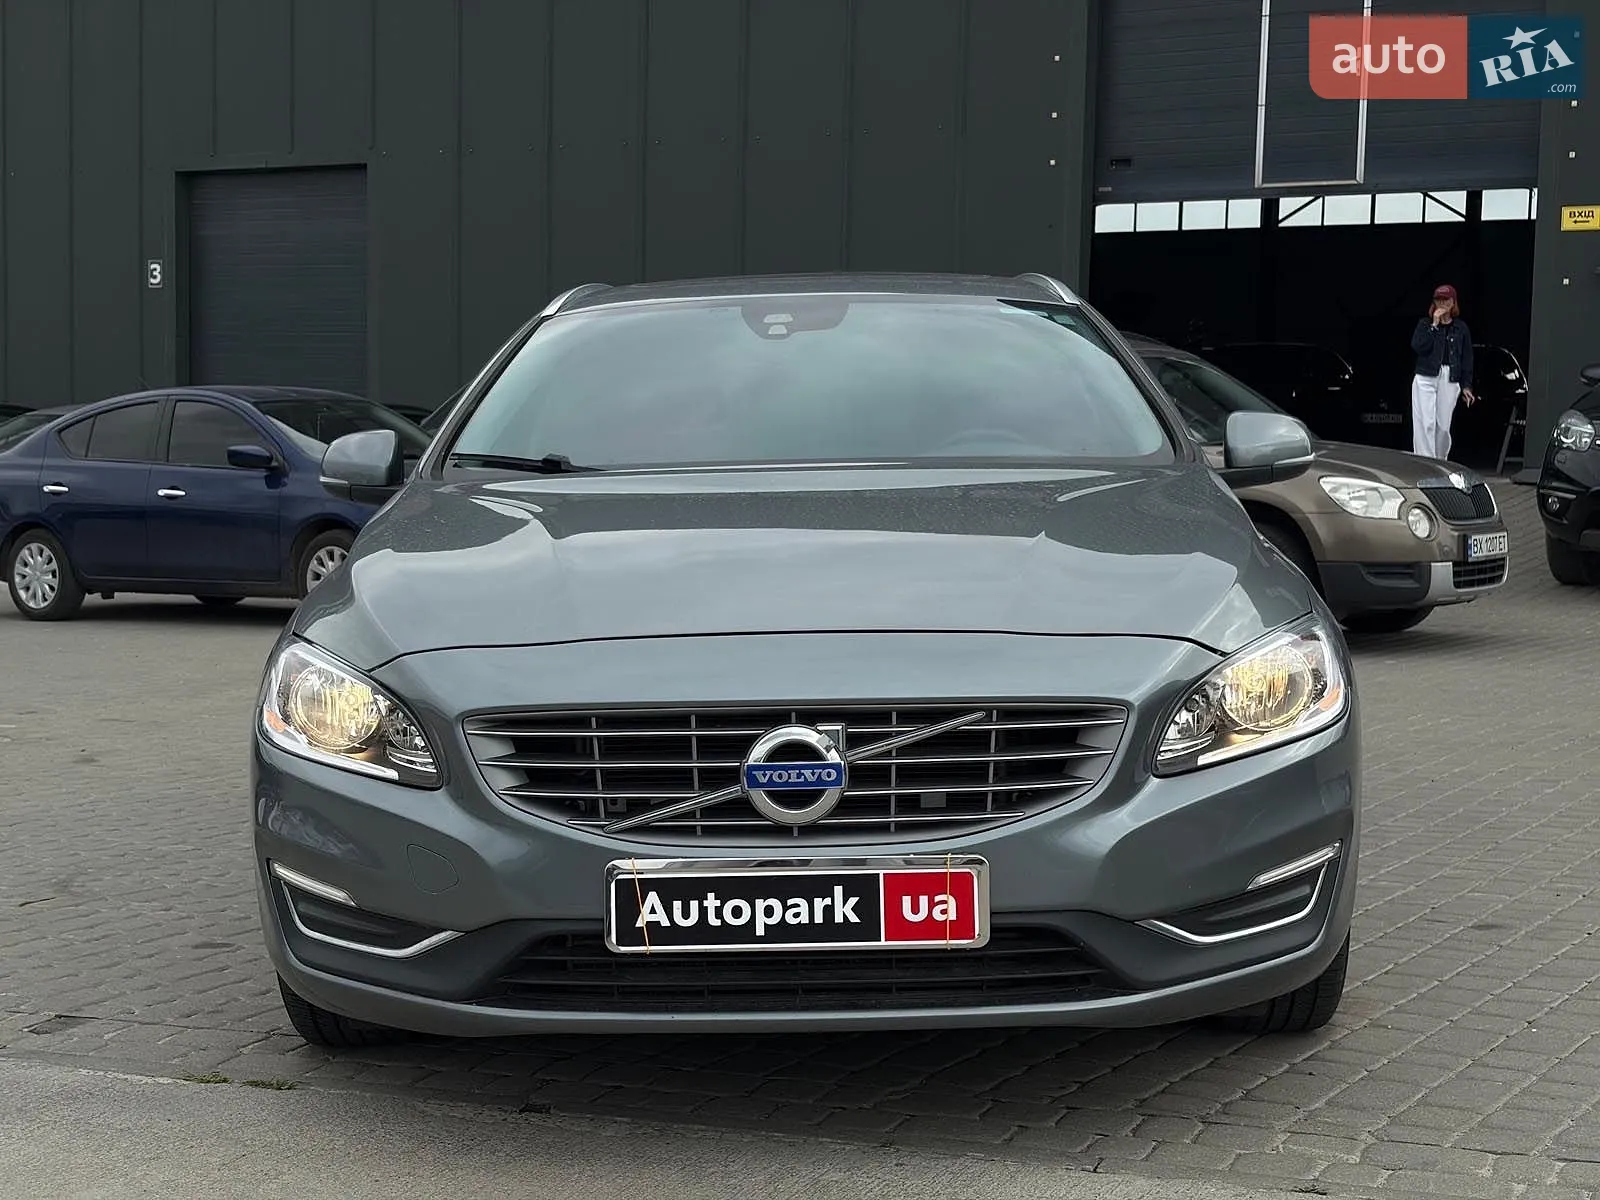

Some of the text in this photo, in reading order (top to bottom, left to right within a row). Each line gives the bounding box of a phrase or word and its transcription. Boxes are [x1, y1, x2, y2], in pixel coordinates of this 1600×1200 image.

[1569, 210, 1595, 219] ВХІД
[150, 263, 161, 284] 3
[751, 768, 837, 783] VOLVO
[635, 885, 957, 936] Autopark ua
